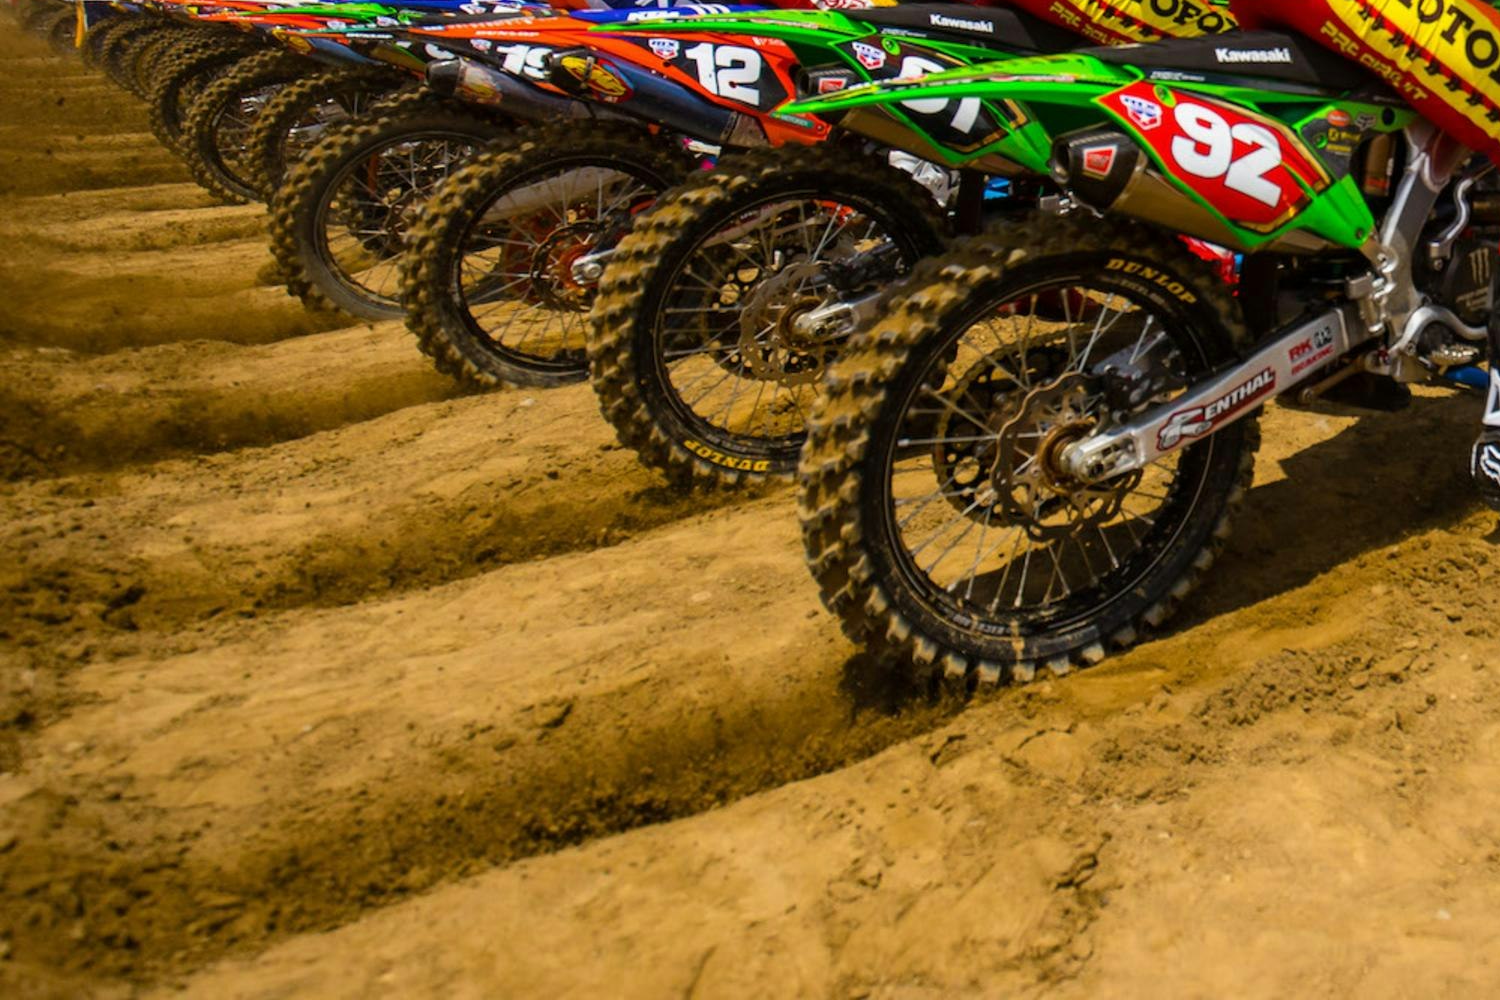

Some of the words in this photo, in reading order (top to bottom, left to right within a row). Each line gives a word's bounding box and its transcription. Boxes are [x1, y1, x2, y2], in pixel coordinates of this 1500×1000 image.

[930, 14, 994, 34] Kawasaki
[1215, 48, 1293, 64] Kawasaki
[685, 42, 761, 107] 12
[1171, 102, 1282, 208] 92
[1104, 259, 1197, 304] DUNLOP
[1288, 338, 1313, 362] RK
[683, 439, 771, 472] DUNLOP
